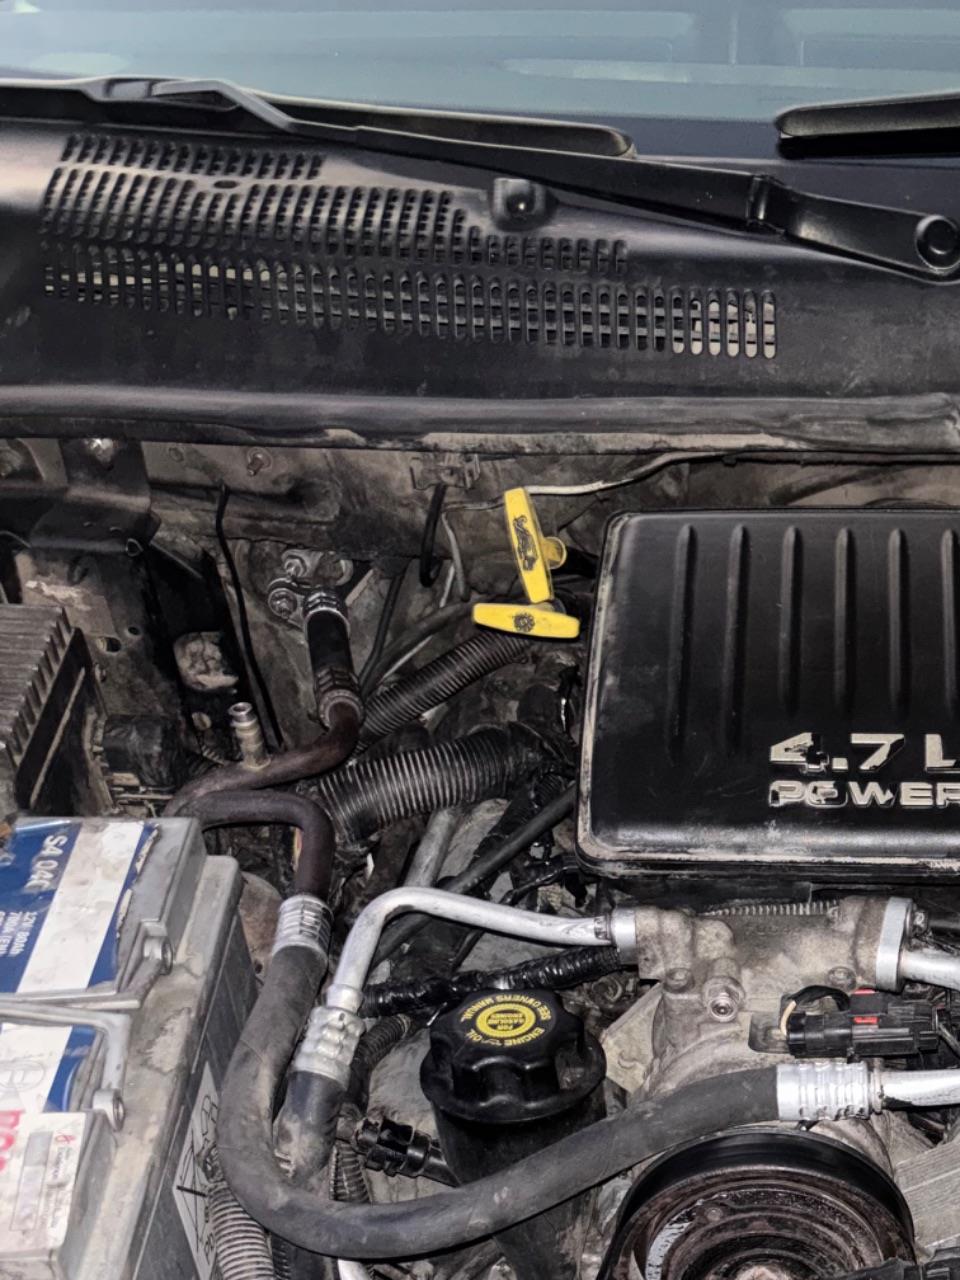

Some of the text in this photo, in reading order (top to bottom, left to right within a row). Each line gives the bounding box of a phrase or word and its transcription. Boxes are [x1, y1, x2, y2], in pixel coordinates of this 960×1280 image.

[769, 731, 905, 773] 4.7
[466, 1027, 545, 1047] ENGINE OIL
